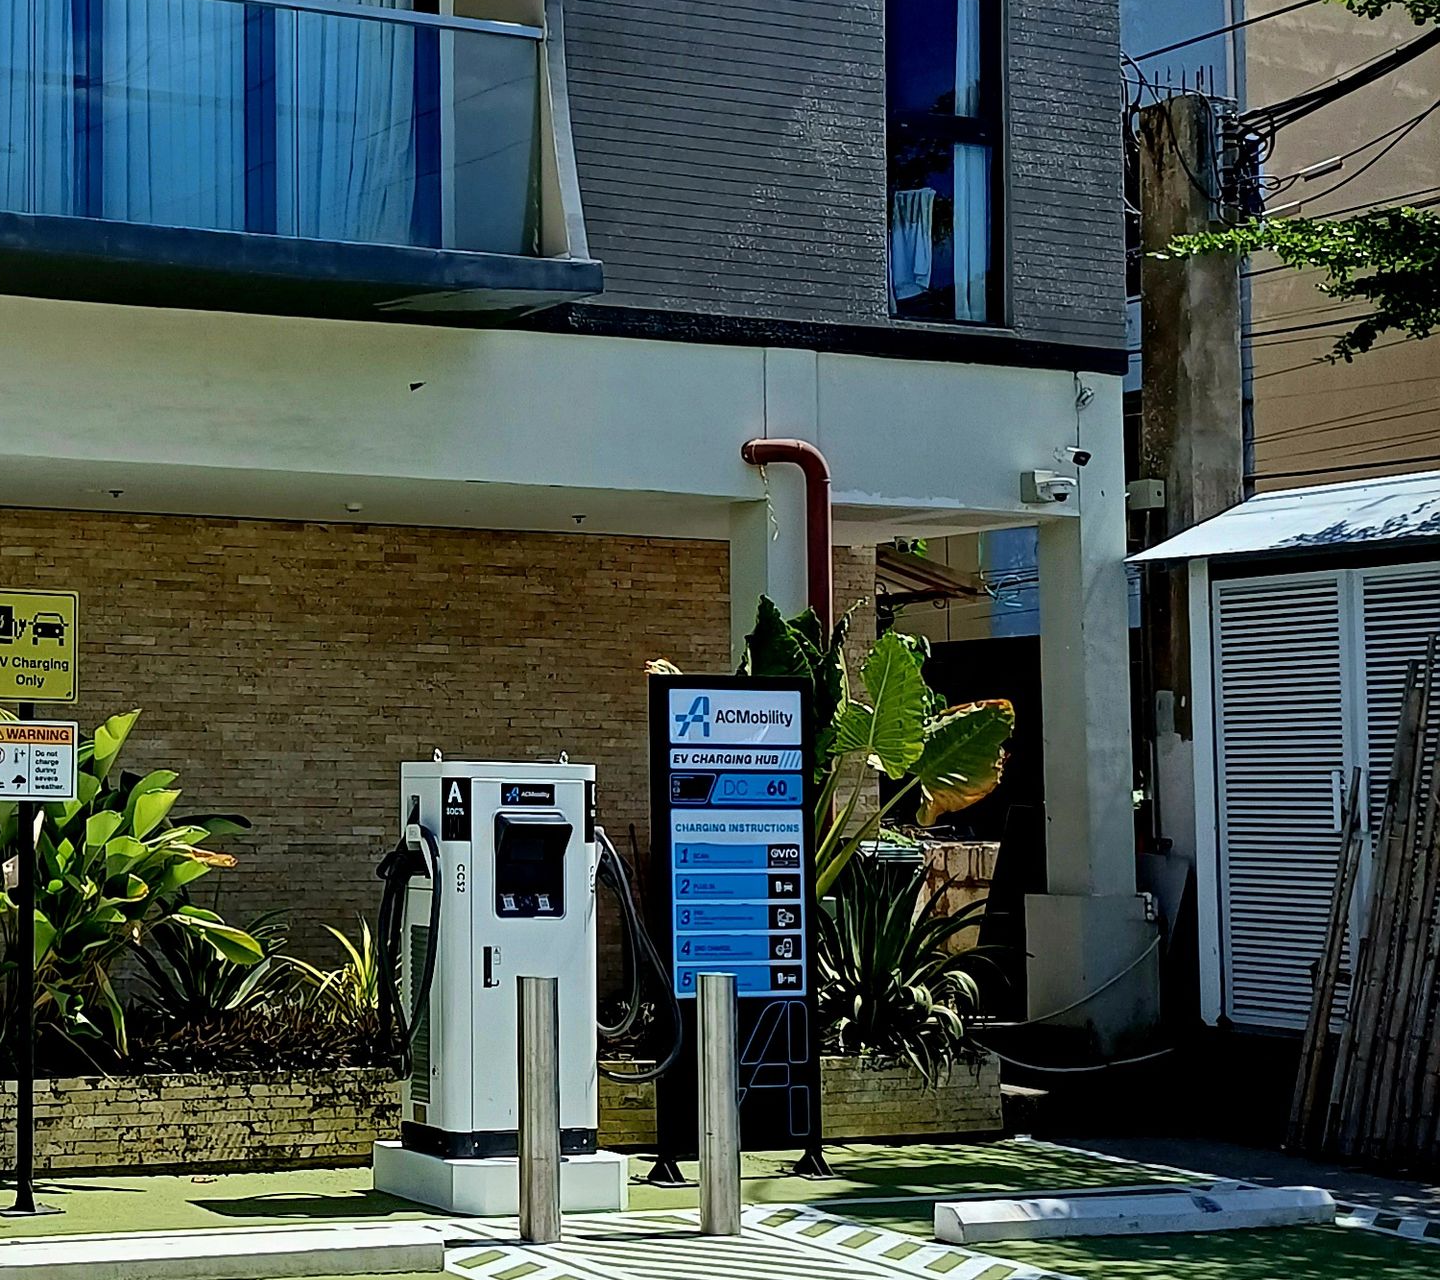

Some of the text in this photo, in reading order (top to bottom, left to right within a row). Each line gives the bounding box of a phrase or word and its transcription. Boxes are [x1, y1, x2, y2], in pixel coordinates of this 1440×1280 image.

[12, 657, 69, 672] Charging
[16, 674, 45, 688] Only
[715, 710, 793, 727] ACMobility
[6, 728, 69, 740] WARNING
[673, 754, 779, 765] EV CHARGING HUB
[448, 781, 463, 803] A
[723, 780, 787, 796] DC 60
[675, 824, 800, 833] CHARGING INSTRUCTIONS
[680, 848, 689, 863] 1
[456, 863, 466, 893] CCS2
[680, 879, 690, 894] 2
[681, 910, 690, 925] 3
[681, 940, 691, 956] 4
[682, 972, 692, 986] 5
